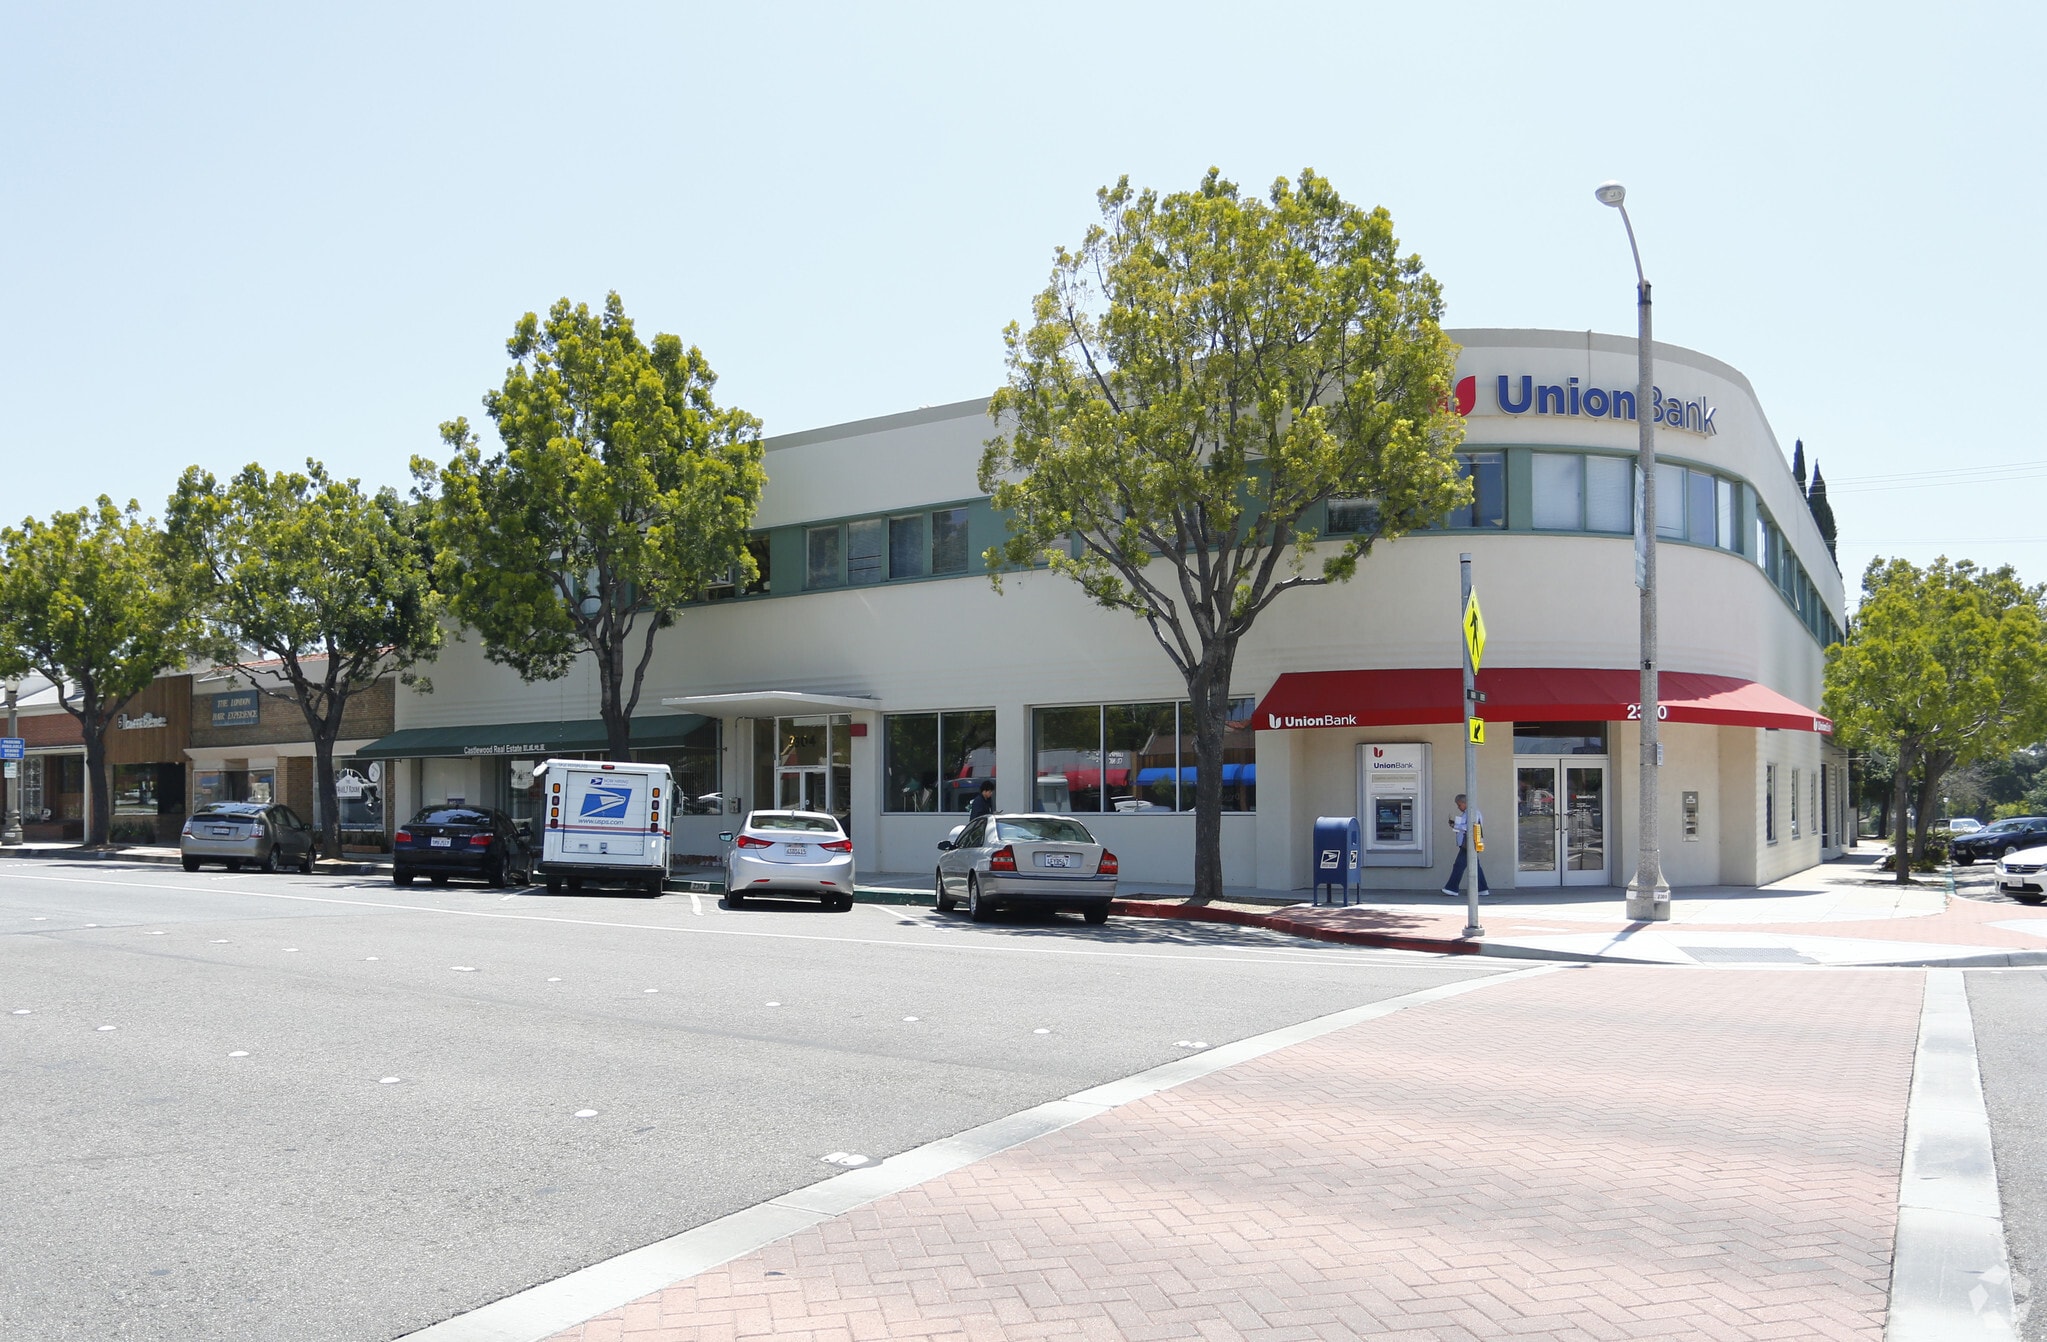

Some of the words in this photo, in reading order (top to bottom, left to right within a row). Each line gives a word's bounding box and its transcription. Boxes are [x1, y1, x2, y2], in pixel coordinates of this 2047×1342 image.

[227, 710, 257, 720] EXPERIENCE
[1284, 714, 1357, 727] UnionBank
[463, 746, 493, 755] Castlewood
[493, 745, 505, 753] Real
[506, 744, 522, 753] Estate
